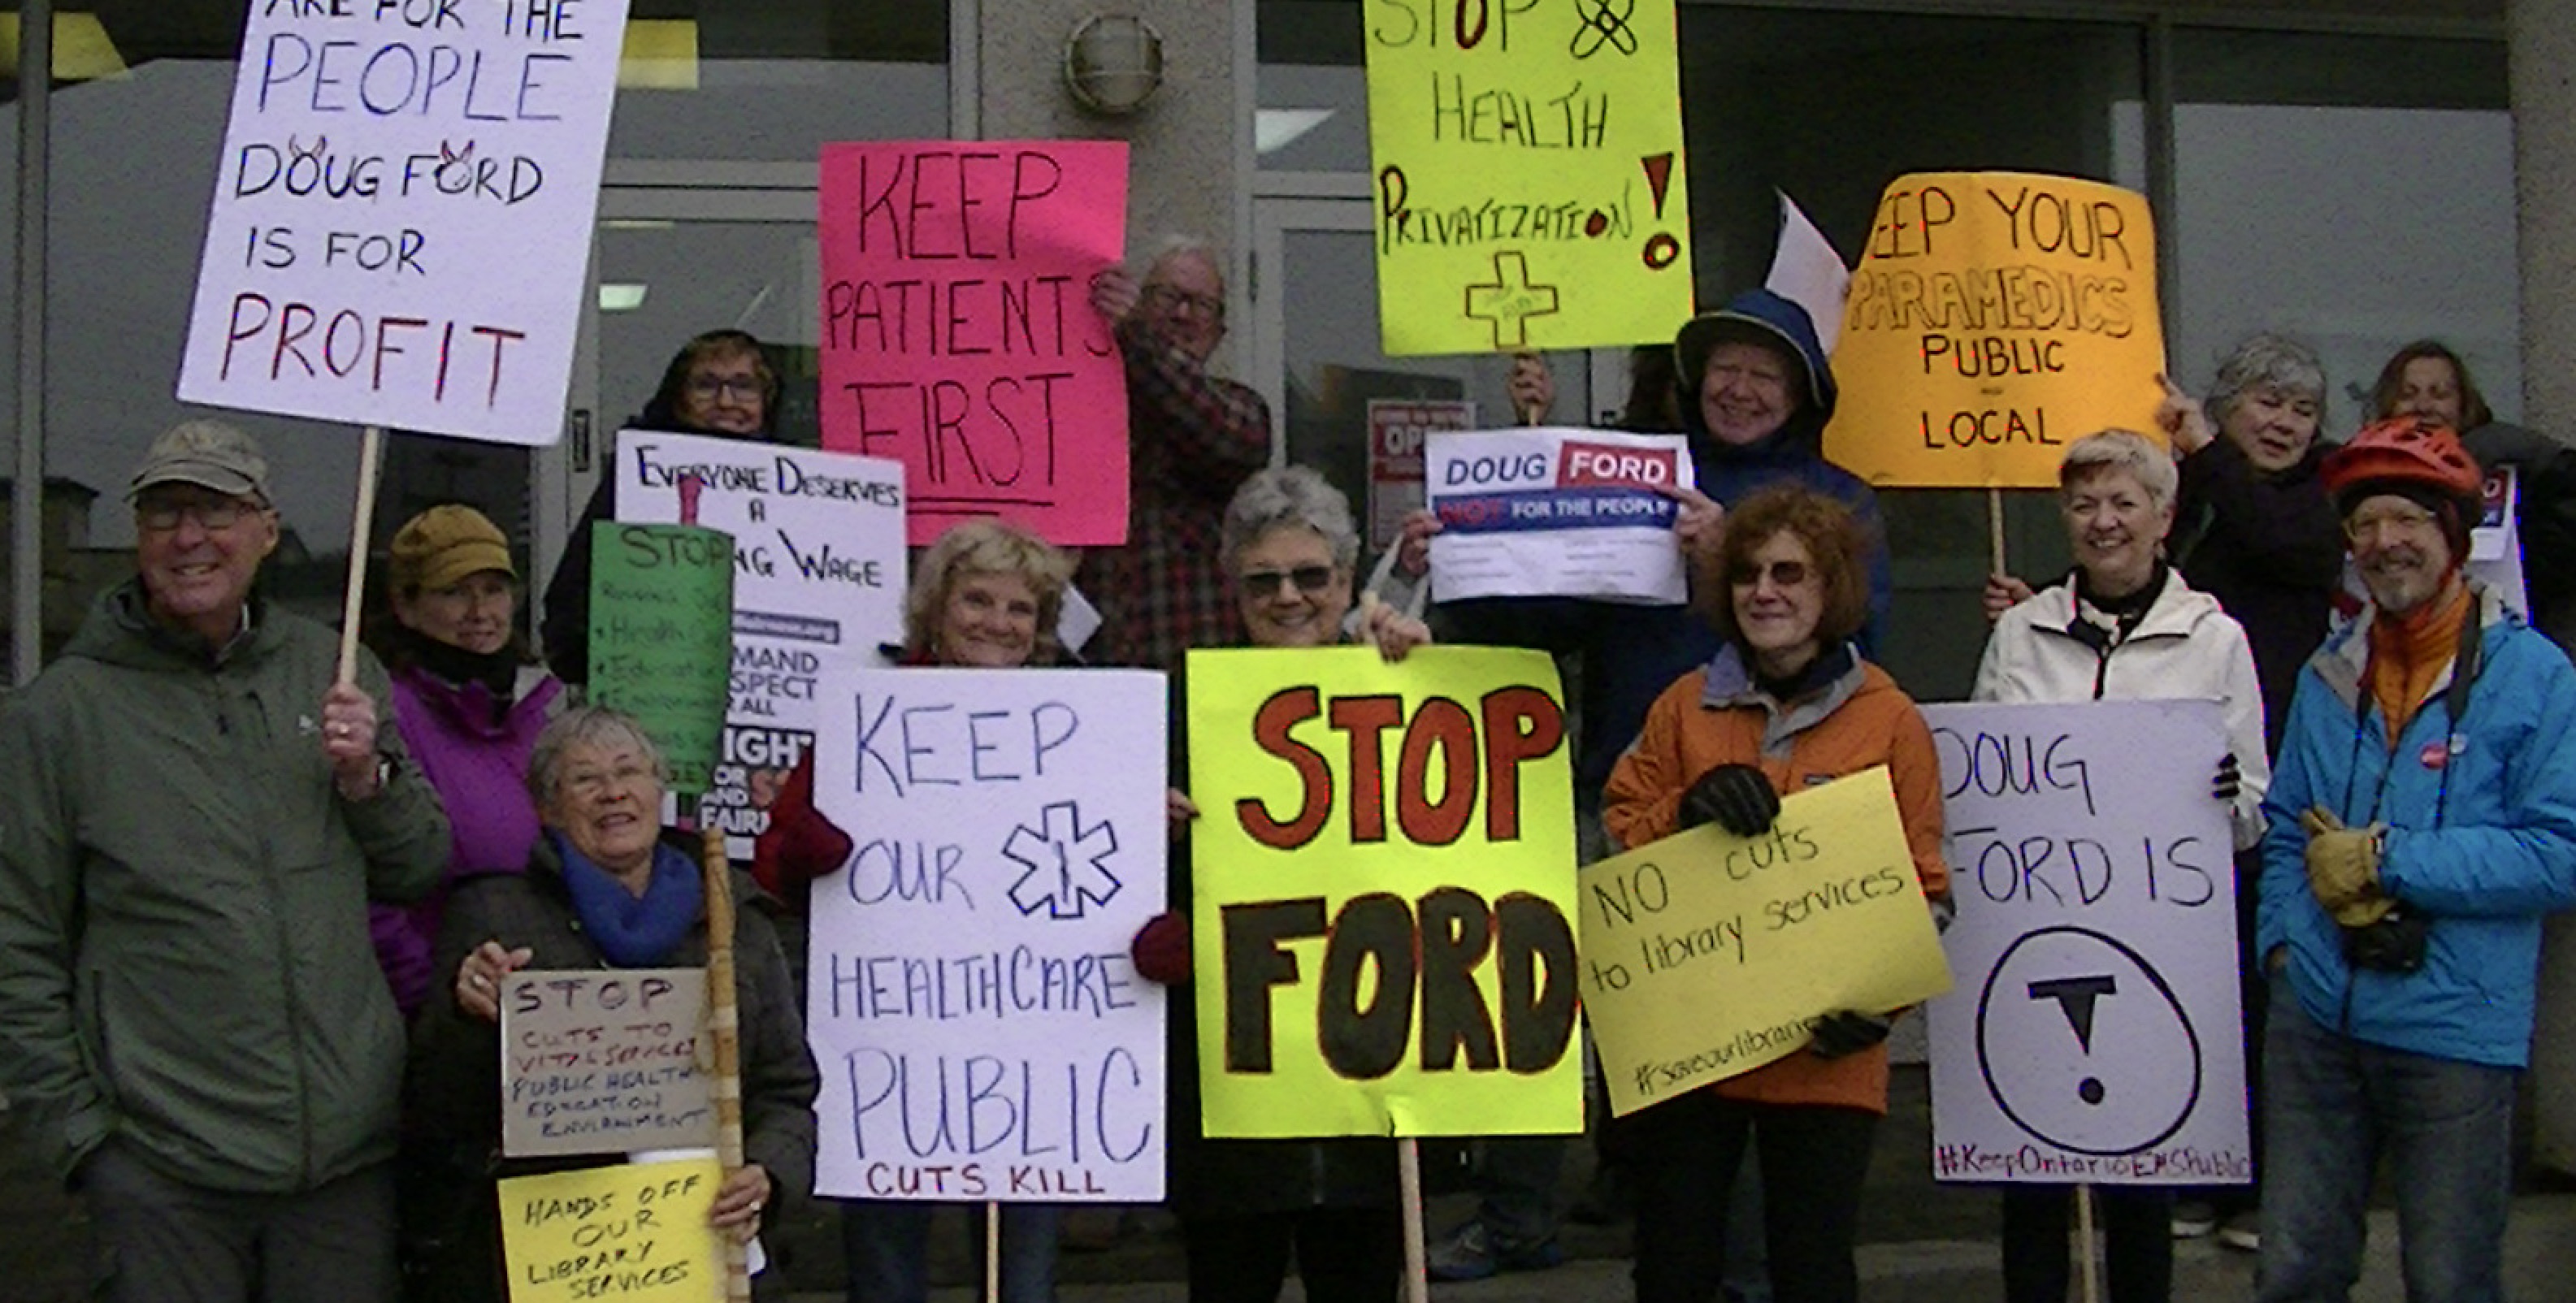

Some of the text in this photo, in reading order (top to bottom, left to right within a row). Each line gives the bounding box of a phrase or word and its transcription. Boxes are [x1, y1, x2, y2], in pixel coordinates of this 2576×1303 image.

[258, 32, 574, 122] PEOPLE
[1433, 71, 1608, 149] HEALTH
[235, 141, 544, 206] DOUG FORD
[860, 150, 1063, 260] KEEP
[1987, 186, 2132, 271] YOUR
[245, 227, 427, 275] IS FOR
[1849, 265, 2133, 340] PARAMEDICS
[219, 292, 526, 411] PROFIT
[1921, 333, 2065, 378] PUBLIC
[843, 371, 1076, 487] FIRST
[1921, 407, 2062, 448] LOCAL
[775, 456, 900, 508] DESERVES
[1446, 450, 1667, 487] DOUG FORD
[748, 498, 765, 522] A
[1438, 499, 1503, 525] NOT
[1511, 500, 1551, 519] FOR
[1555, 498, 1593, 517] THE
[621, 526, 726, 568] STOP
[777, 528, 883, 589] WAGE
[741, 697, 776, 716] ALL
[855, 693, 1080, 798] KEEP
[1235, 684, 1566, 851] STOP
[848, 838, 975, 911] OUR
[1592, 824, 1819, 929] NO cuts
[2144, 837, 2214, 907] IS
[1591, 865, 1905, 993] to library services
[514, 977, 674, 1014] STOP
[830, 942, 1138, 1020] HEALTHCARE
[1219, 885, 1580, 1080] FORD
[522, 1021, 673, 1050] CUTS TO
[512, 1066, 693, 1102] PUBLIC HEALTH
[843, 1046, 1151, 1164] PUBLIC
[525, 1174, 700, 1227] HANDS OFF
[866, 1161, 1105, 1197] CUTS KILL
[571, 1210, 661, 1248] OUR
[527, 1241, 653, 1285] LIBRARY
[569, 1260, 691, 1300] SERVICES
